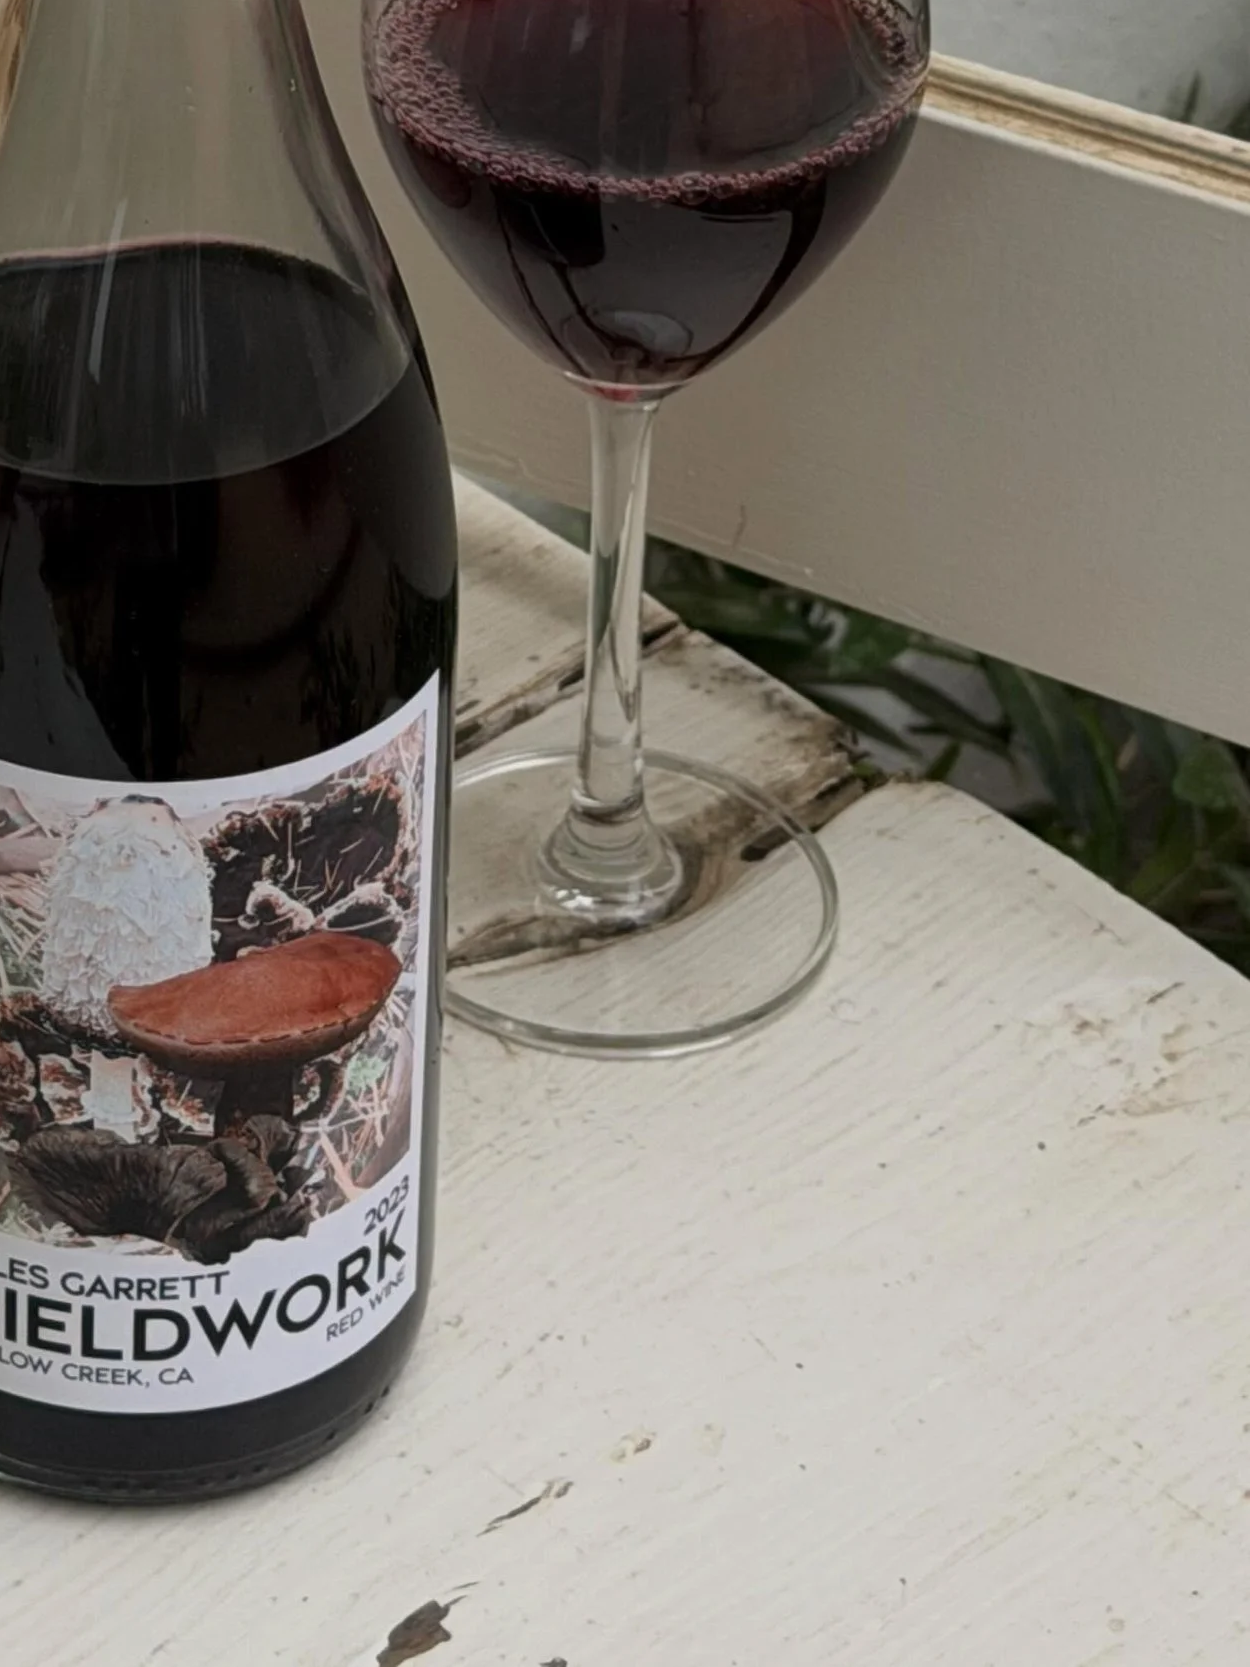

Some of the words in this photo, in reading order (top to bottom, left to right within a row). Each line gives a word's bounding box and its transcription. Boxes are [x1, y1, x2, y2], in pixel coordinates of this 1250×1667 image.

[363, 1174, 410, 1236] 2023
[60, 1270, 230, 1301] GARRETT
[326, 1306, 364, 1342] RED
[369, 1263, 407, 1311] WINE
[61, 1363, 151, 1389] CREEK,
[158, 1367, 195, 1385] CA
